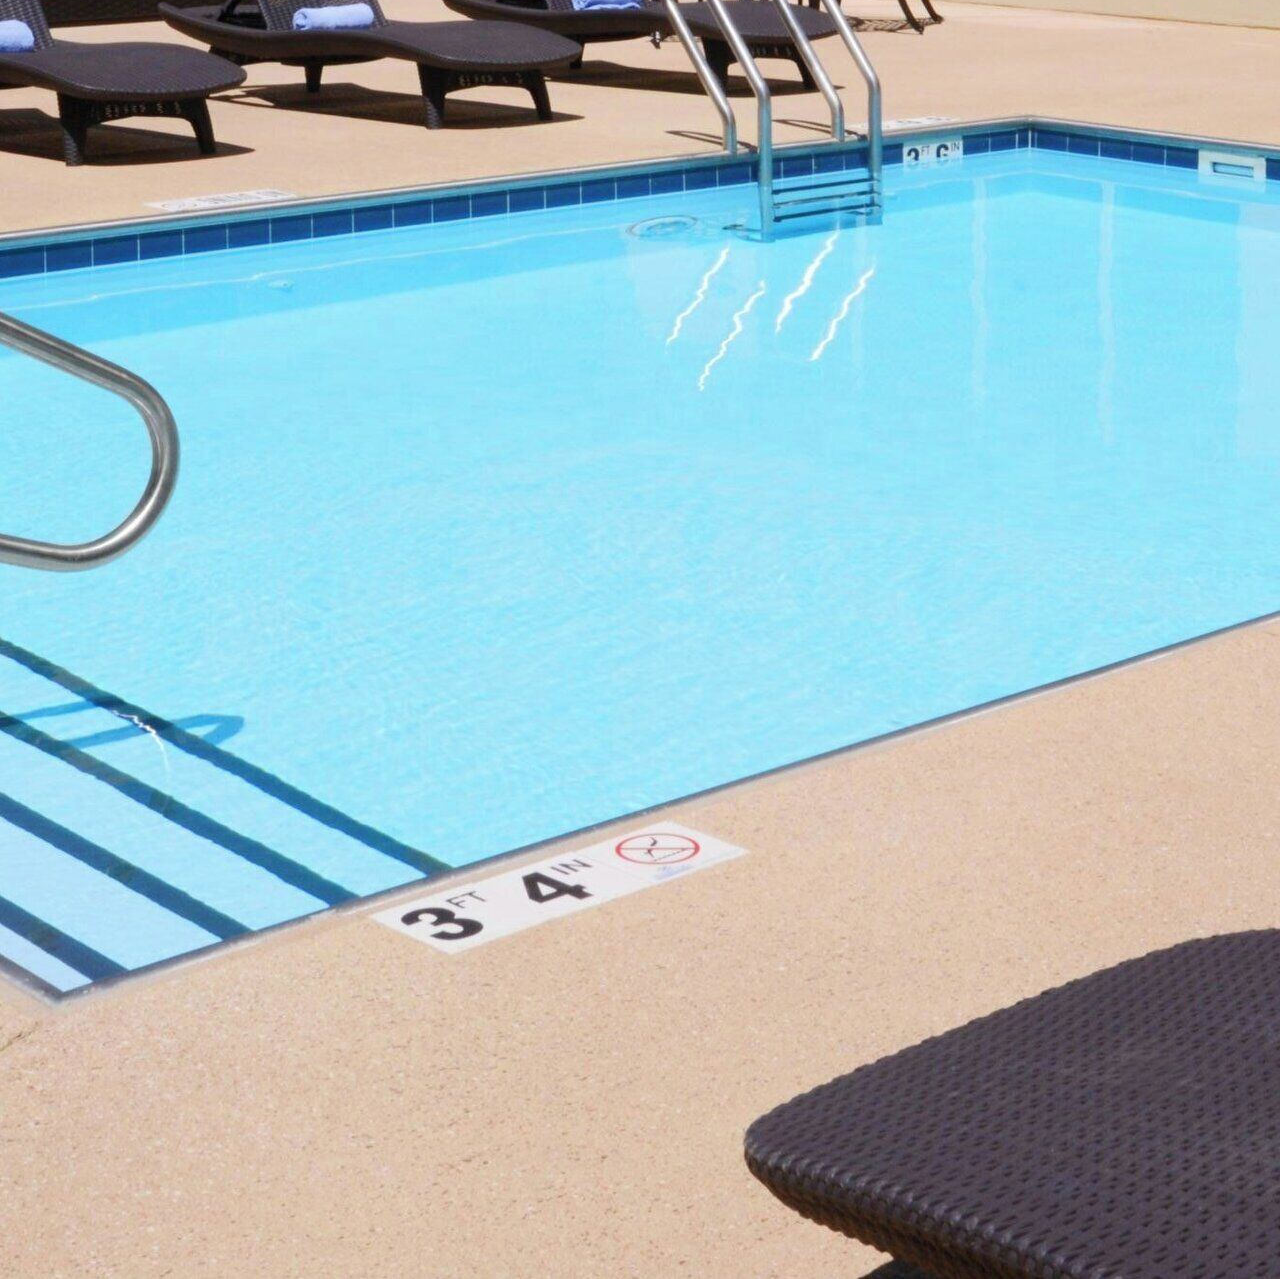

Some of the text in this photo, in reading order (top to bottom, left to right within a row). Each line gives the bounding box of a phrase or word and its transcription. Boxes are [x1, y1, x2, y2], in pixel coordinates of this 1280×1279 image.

[401, 858, 595, 941] 3 FT 4 IN
